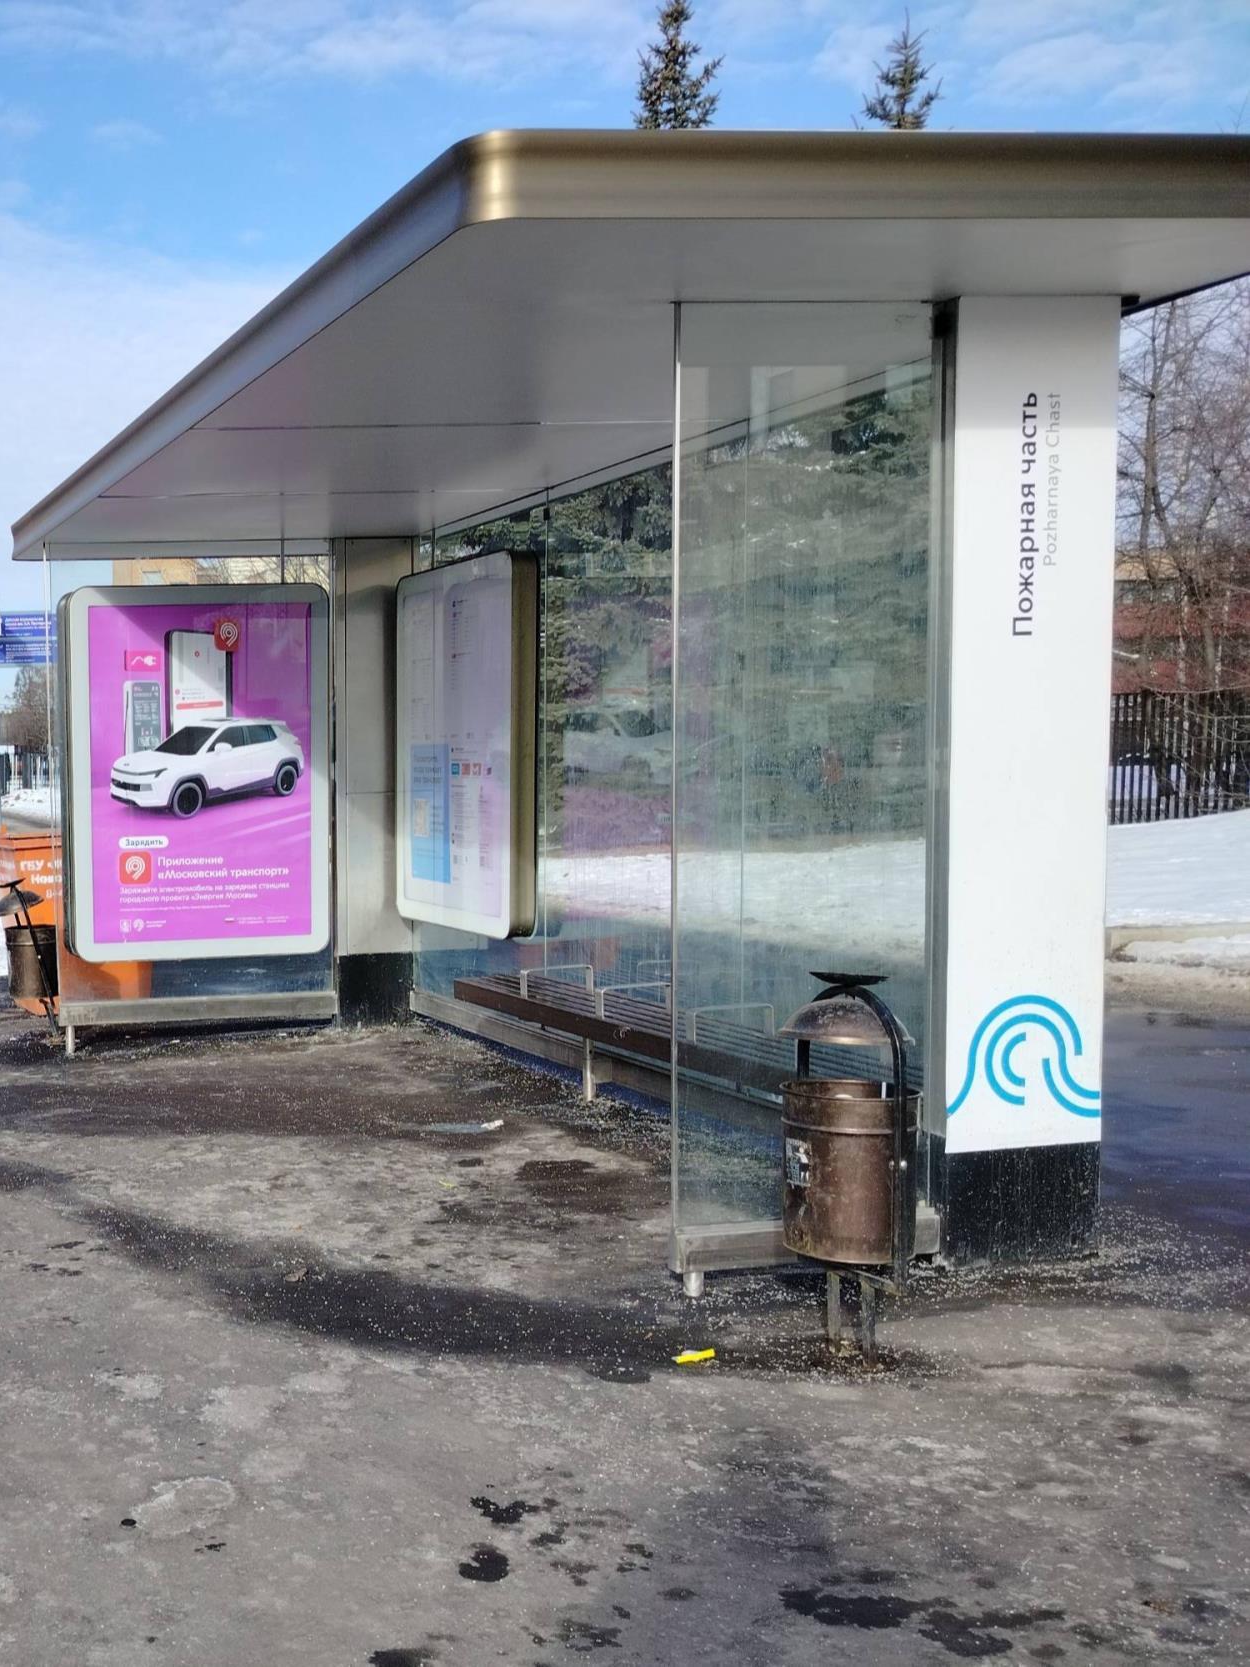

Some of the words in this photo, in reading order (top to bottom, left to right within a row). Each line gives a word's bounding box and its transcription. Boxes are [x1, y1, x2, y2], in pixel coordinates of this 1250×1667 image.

[1021, 392, 1038, 474] часть
[1045, 392, 1061, 448] Chast
[1042, 453, 1061, 567] Pozharnaya
[1012, 482, 1040, 637] Пожарная
[124, 838, 164, 848] Зарядить
[157, 856, 224, 868] Приложение
[158, 868, 228, 880] «Московский
[230, 867, 289, 879] транспорт»
